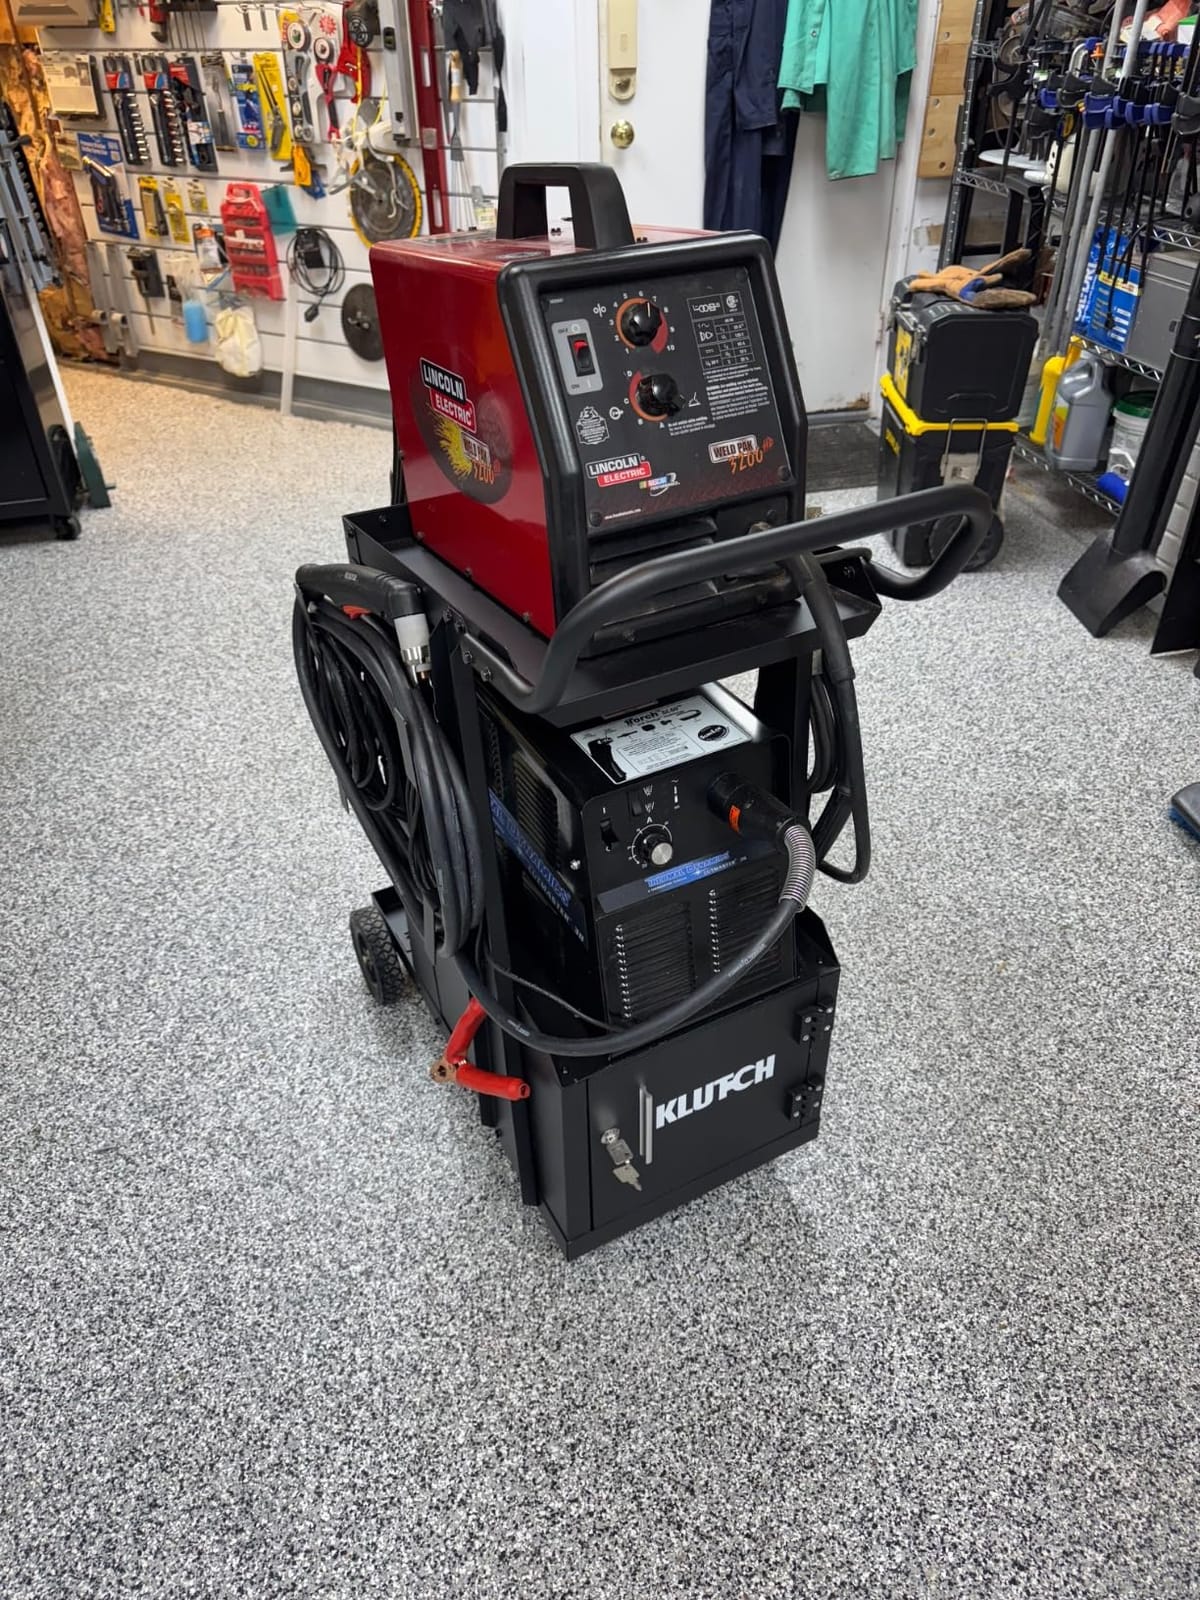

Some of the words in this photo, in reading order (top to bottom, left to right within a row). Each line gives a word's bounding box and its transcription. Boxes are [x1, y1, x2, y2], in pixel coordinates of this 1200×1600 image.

[667, 344, 676, 352] 10
[422, 363, 464, 401] LINCOLN
[435, 393, 472, 427] ELECTRIC
[713, 444, 737, 458] WELD
[738, 440, 754, 453] PAK
[588, 455, 639, 476] LINCOLN
[603, 467, 646, 484] ELECTRIC
[656, 1053, 776, 1130] KLUTCH
